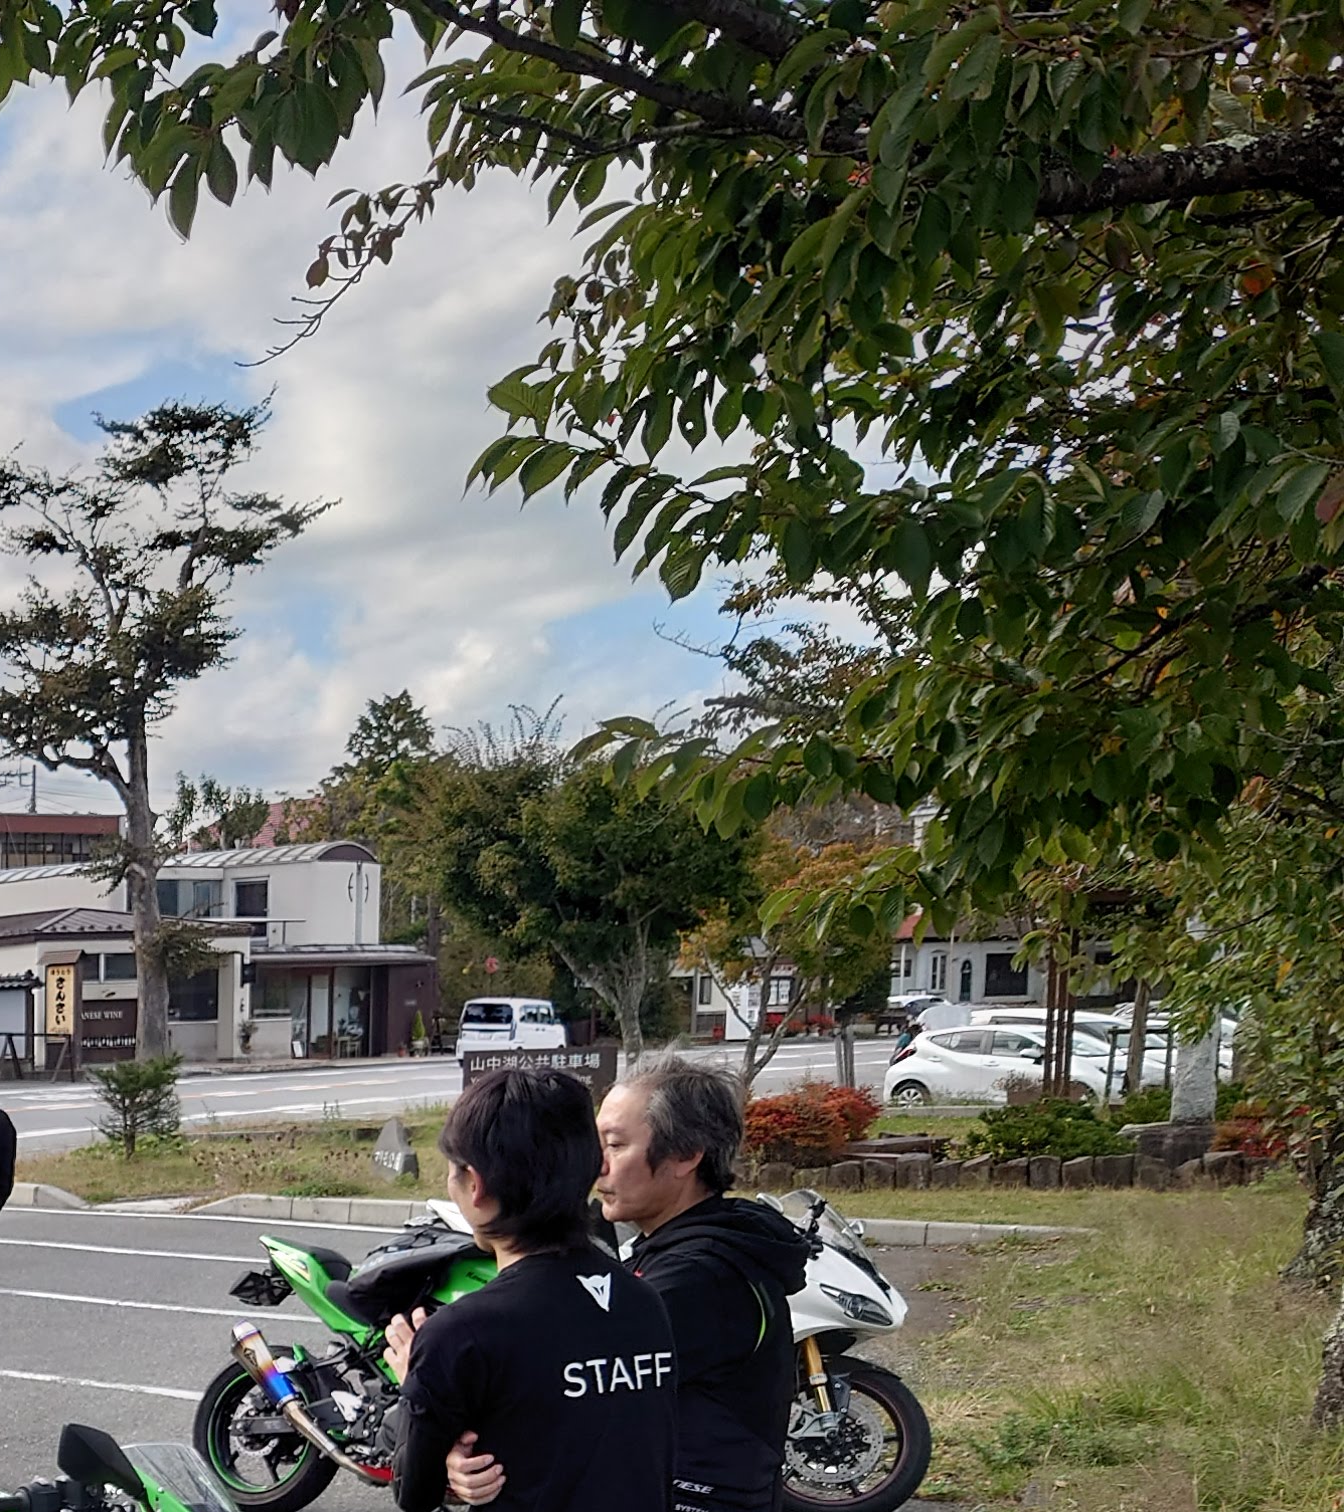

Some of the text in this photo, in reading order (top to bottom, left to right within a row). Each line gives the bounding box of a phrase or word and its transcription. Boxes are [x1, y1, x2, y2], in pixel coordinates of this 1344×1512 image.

[55, 977, 66, 1025] さんさい
[103, 1010, 123, 1019] WINE
[470, 1053, 601, 1071] 山中湖公共駐車場
[563, 1352, 674, 1398] STAFF
